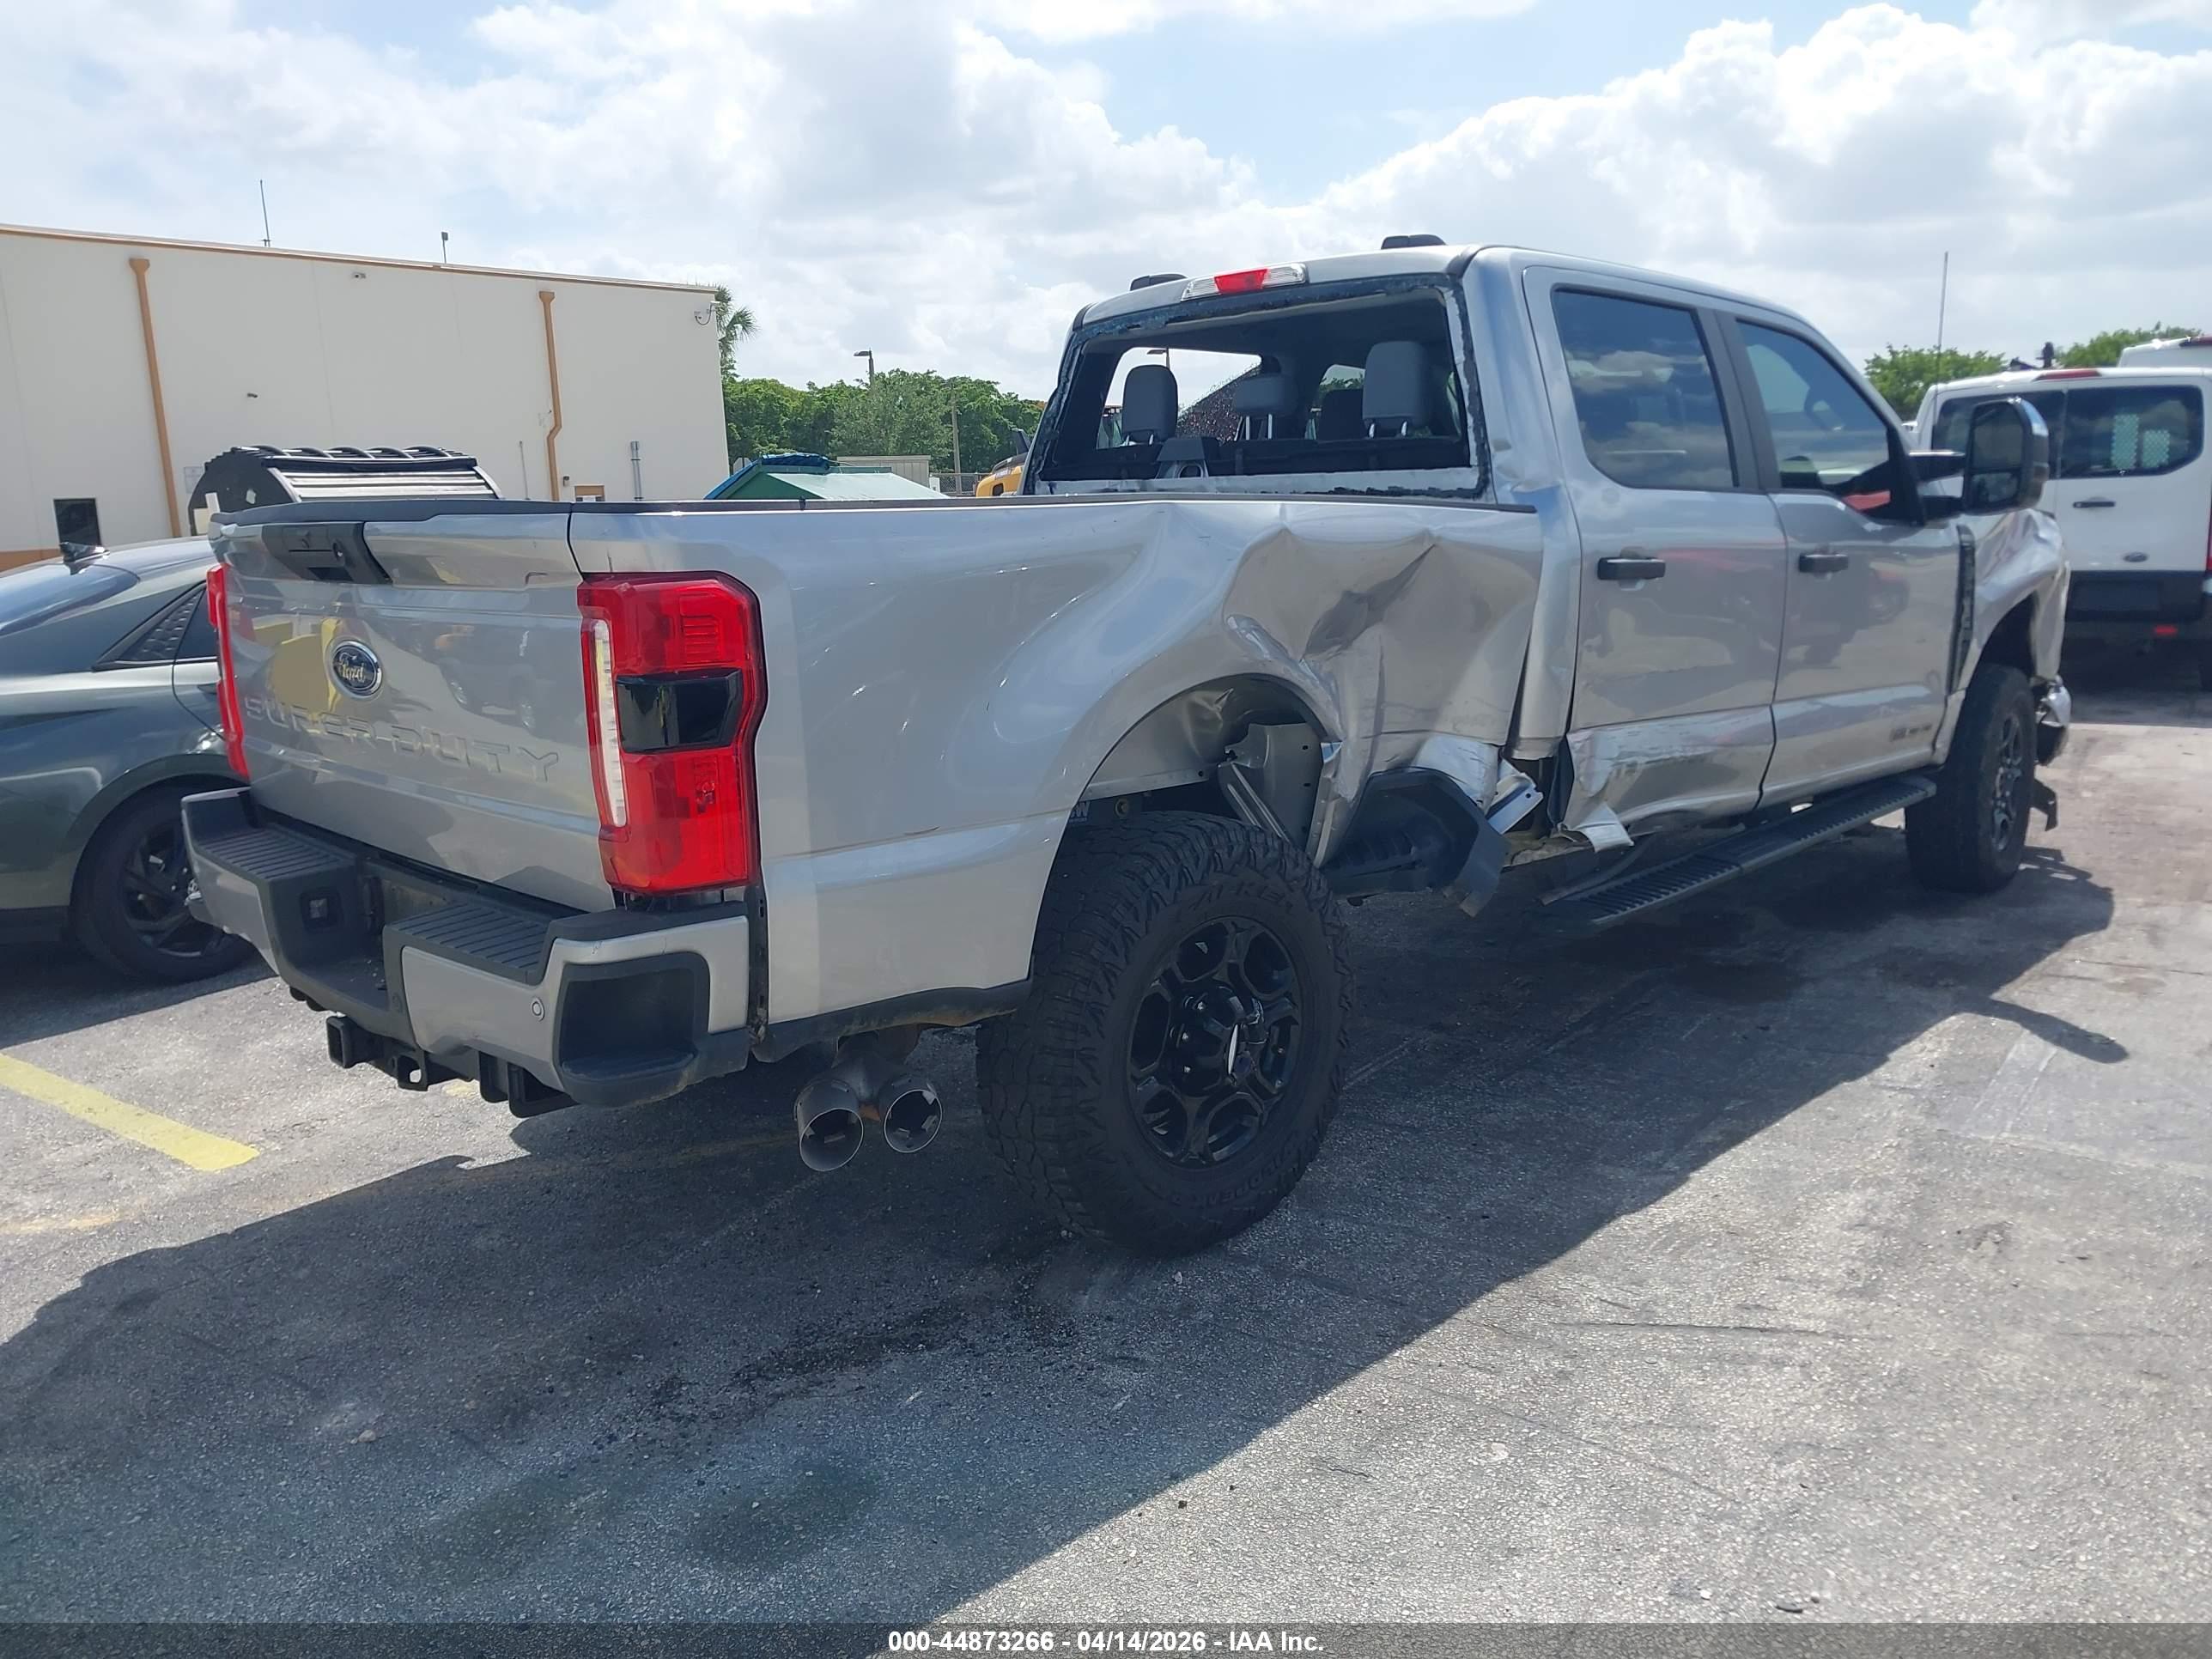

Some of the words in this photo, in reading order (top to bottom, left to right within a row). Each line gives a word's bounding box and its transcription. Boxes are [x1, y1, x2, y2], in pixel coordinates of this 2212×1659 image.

[334, 652, 366, 684] Ford
[245, 696, 377, 750] SUPER
[390, 724, 560, 782] DUTY
